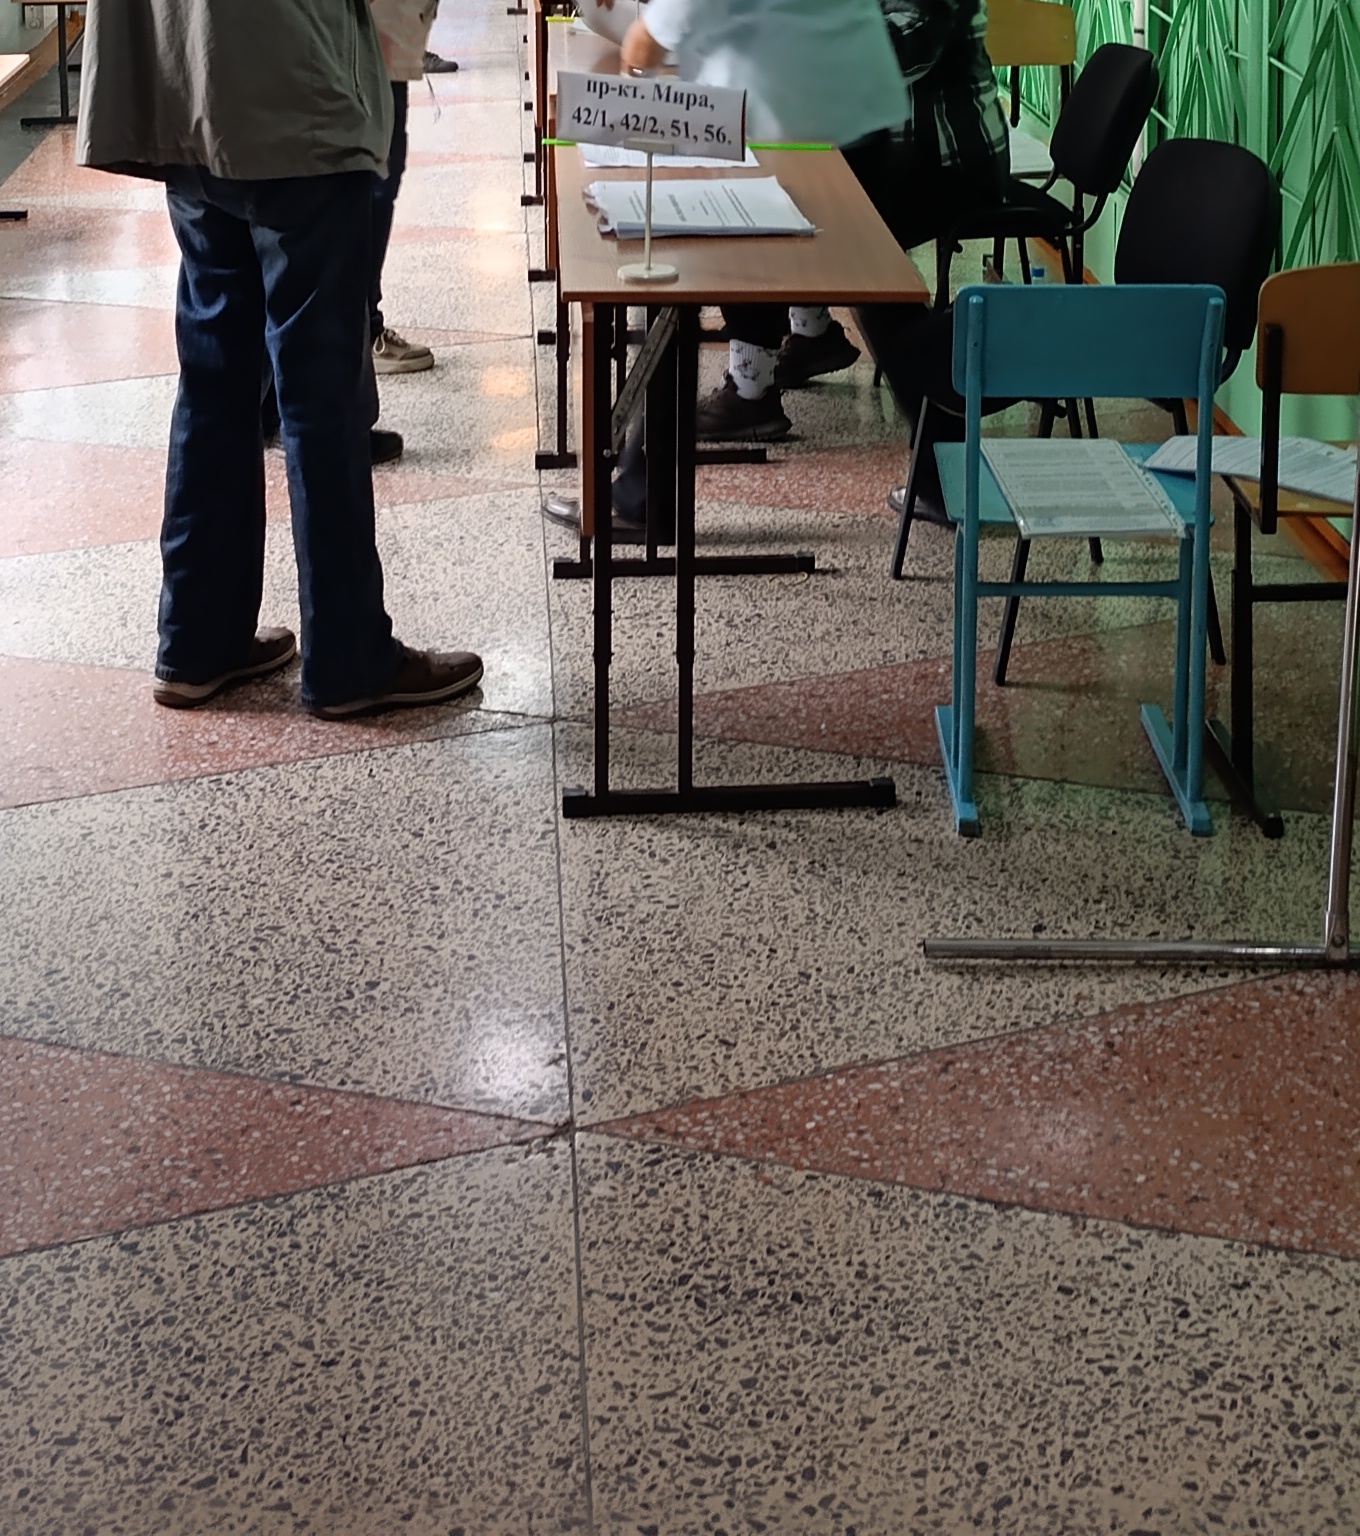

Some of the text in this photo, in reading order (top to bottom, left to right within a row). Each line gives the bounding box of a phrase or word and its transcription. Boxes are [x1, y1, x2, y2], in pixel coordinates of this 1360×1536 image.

[586, 79, 715, 112] пр-кт. Мира,
[572, 106, 732, 146] 42/1, 42/2, 51, 56.
